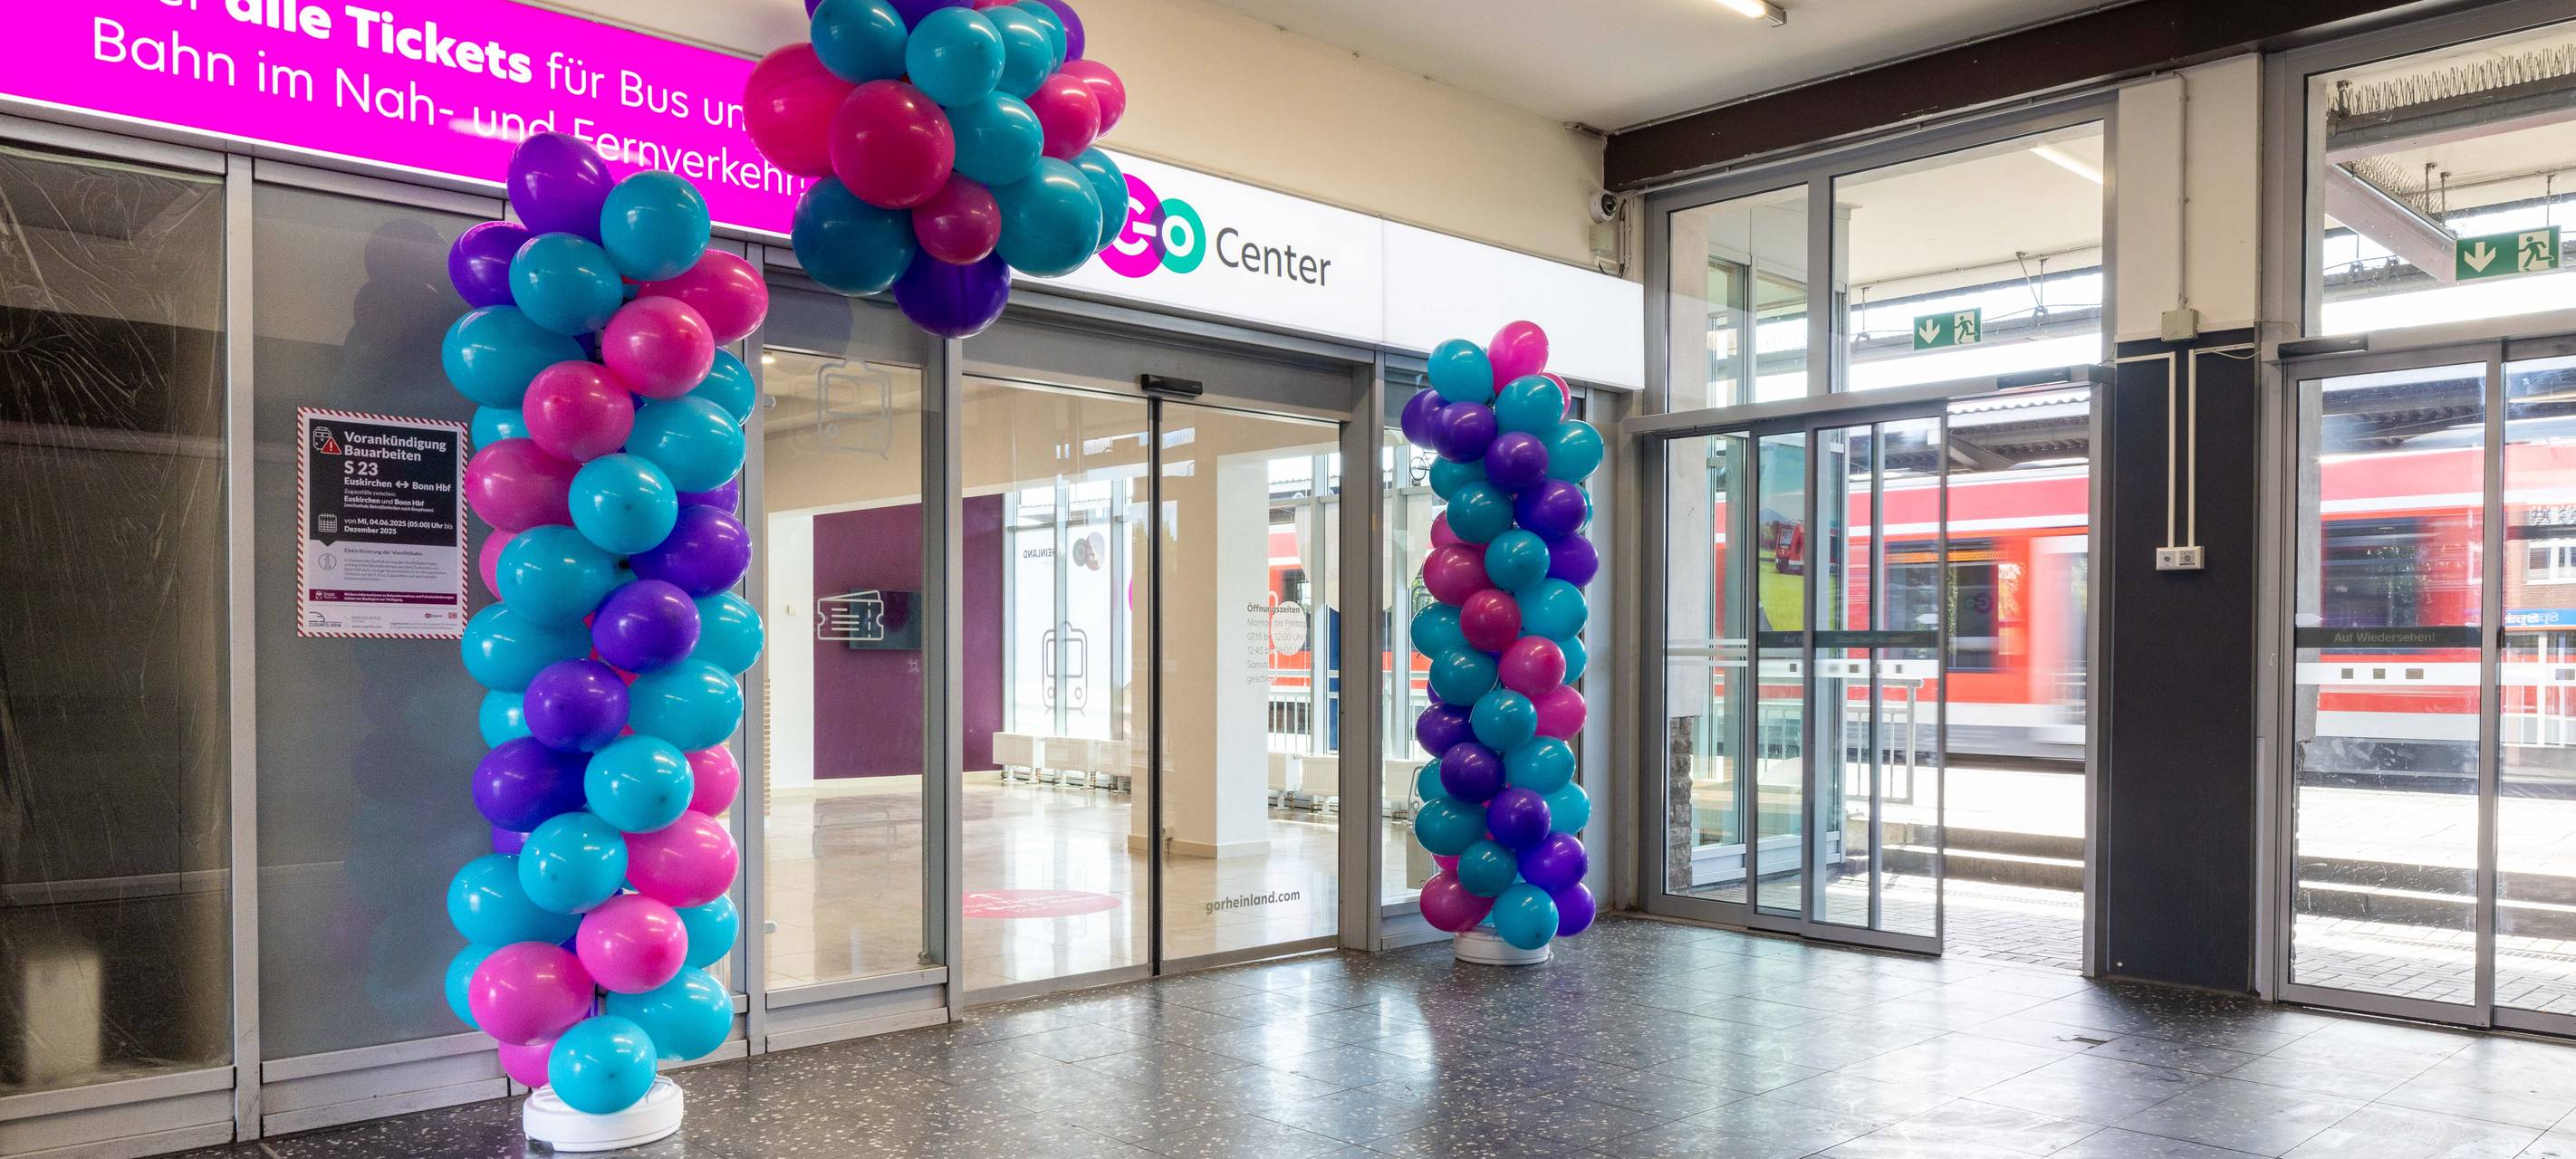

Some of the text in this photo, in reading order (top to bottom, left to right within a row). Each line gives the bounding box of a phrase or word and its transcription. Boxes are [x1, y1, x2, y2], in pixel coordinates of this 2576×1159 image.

[94, 16, 235, 86] Bahn
[258, 50, 312, 101] im
[336, 67, 453, 126] Nah-
[225, 0, 746, 131] alle Tickets für Bus un
[1216, 226, 1331, 286] Center
[344, 430, 447, 453] Vorankündigung
[344, 445, 422, 462] Bauarbeiten
[344, 461, 379, 476] S 23
[344, 477, 452, 493] Euskirchen Bonn Hbf
[344, 495, 380, 505] Euskirchen
[344, 526, 379, 534] Dezember
[358, 518, 369, 526] Mi,
[370, 519, 407, 528] 04.06.2025
[407, 521, 430, 530] (05:00)
[1246, 602, 1301, 614] Öffnungszeiten
[2334, 632, 2436, 643] Auf Wiedersehen!
[1206, 891, 1301, 915] gorheinland.com
